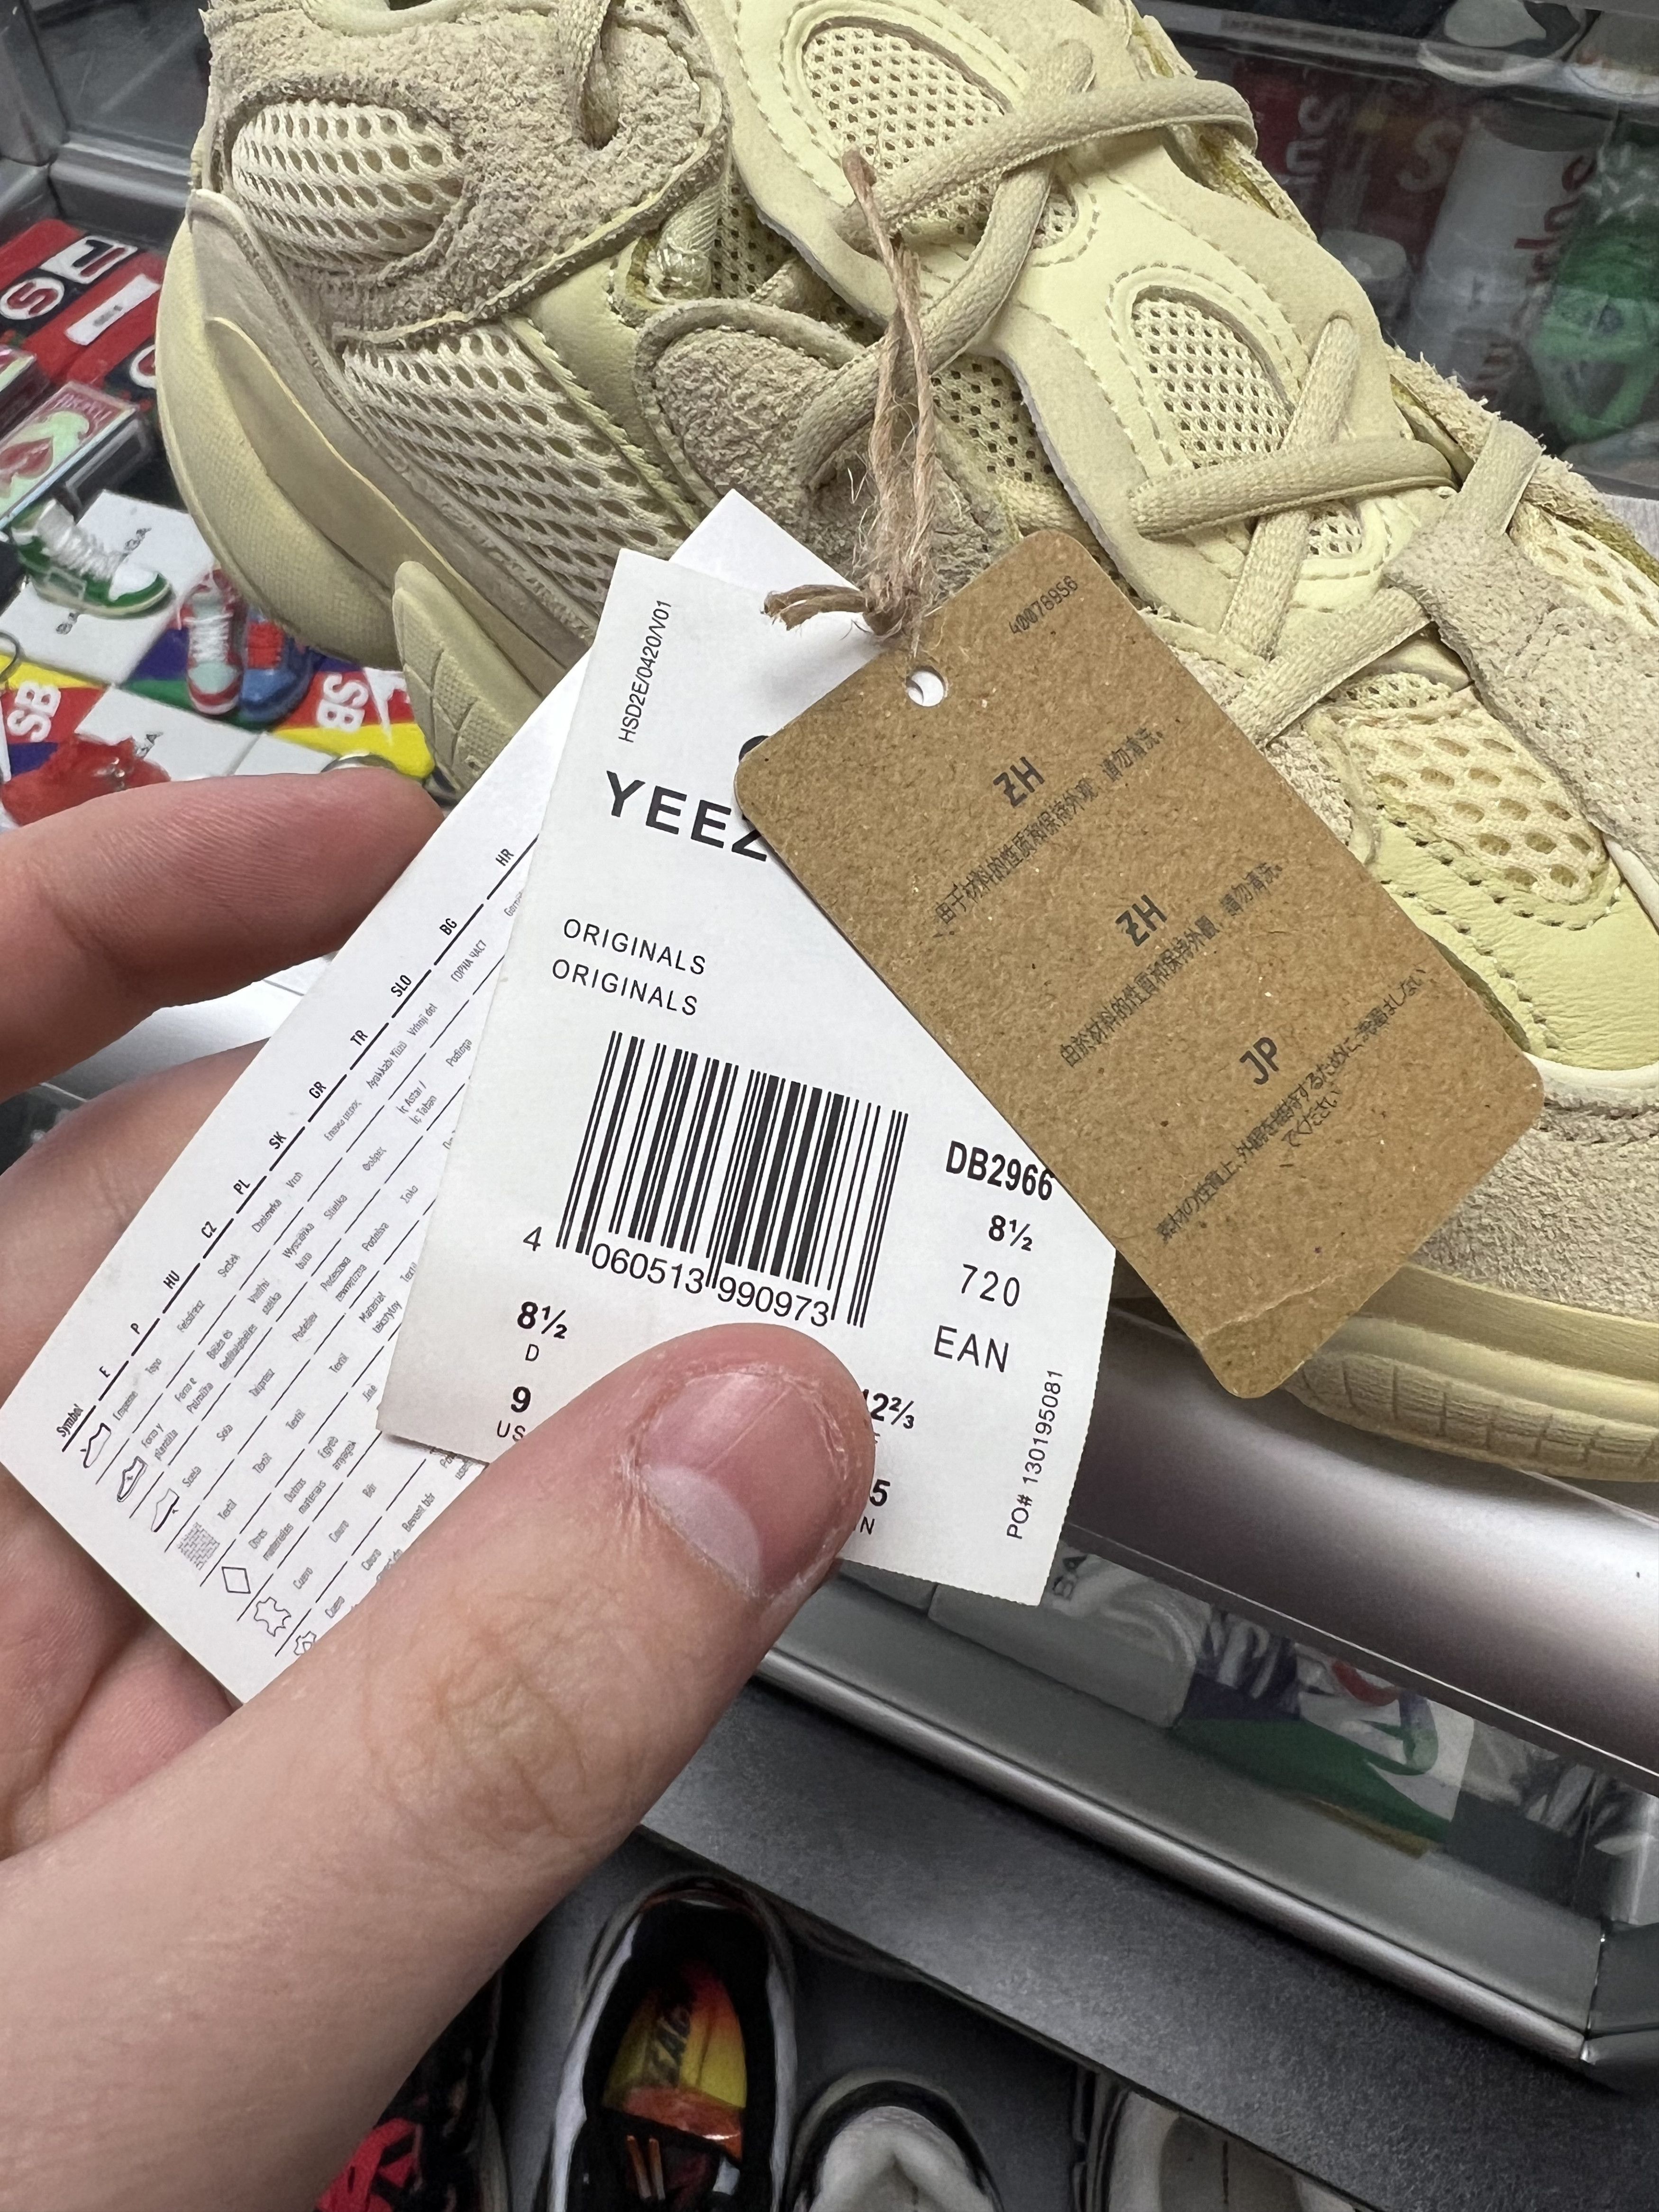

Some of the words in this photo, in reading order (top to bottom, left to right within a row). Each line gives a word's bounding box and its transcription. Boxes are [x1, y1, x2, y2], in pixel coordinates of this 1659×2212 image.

[618, 600, 672, 743] HSD2E/0420/V01
[993, 756, 1046, 809] ZH
[607, 771, 767, 862] YEEZ
[495, 848, 514, 866] HR
[439, 918, 457, 936] BG
[1115, 894, 1167, 947] ZH
[564, 919, 705, 975] ORIGINALS
[391, 974, 412, 997] SLO
[552, 959, 697, 1016] ORIGINALS
[350, 1030, 368, 1046] TR
[1239, 1037, 1279, 1085] JP
[269, 1131, 287, 1150] SK
[946, 1140, 1059, 1201] DB2966
[201, 1221, 217, 1238] CZ
[523, 1226, 542, 1252] 4
[592, 1243, 704, 1294] 060513
[718, 1276, 829, 1327] 990973
[961, 1264, 1020, 1307] 720
[130, 1323, 140, 1335] P
[934, 1325, 1009, 1373] EAN
[99, 1366, 110, 1378] E
[525, 1344, 539, 1362] D
[510, 1386, 531, 1413] 9
[497, 1420, 526, 1442] US
[1006, 1494, 1033, 1539] PO#
[1022, 1370, 1063, 1484] 130195081
